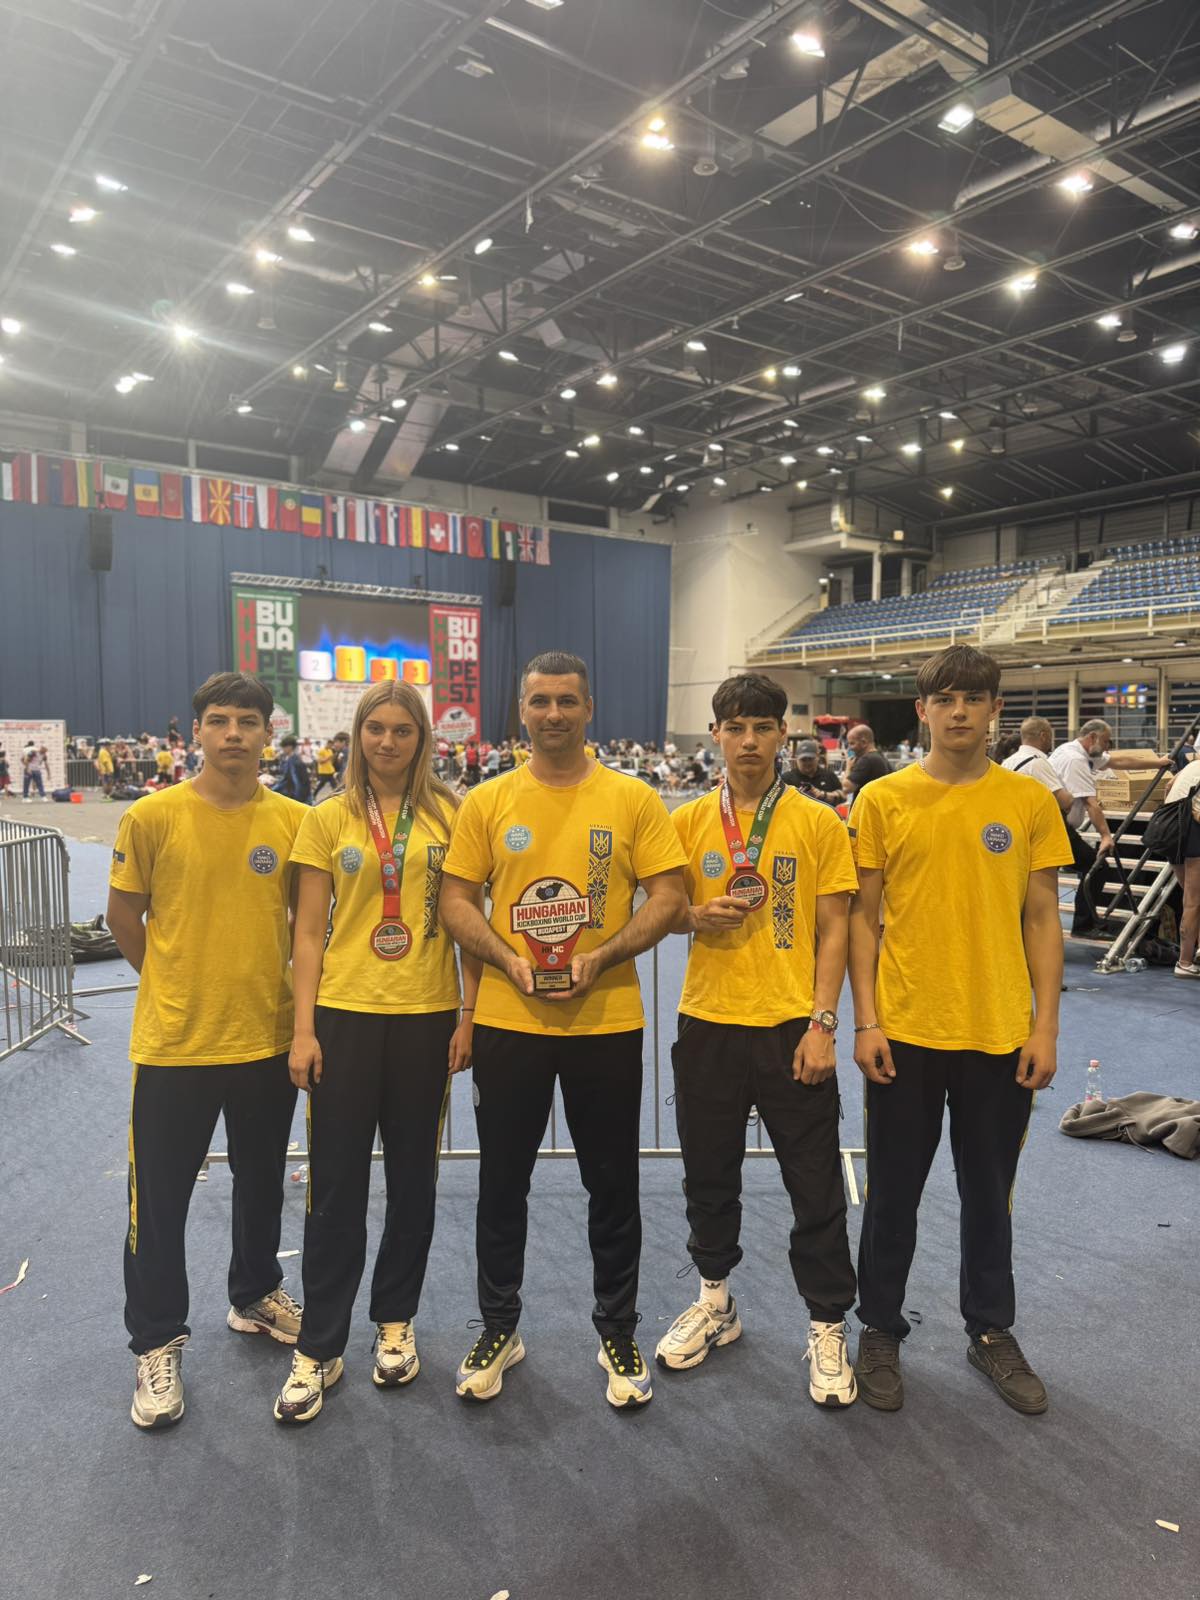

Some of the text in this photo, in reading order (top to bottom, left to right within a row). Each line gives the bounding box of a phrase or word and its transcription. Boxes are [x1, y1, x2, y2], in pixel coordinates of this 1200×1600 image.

[312, 660, 320, 671] 2
[347, 658, 353, 672] 1
[516, 901, 586, 921] HUNGARIAN
[516, 917, 552, 928] KICKBOXING
[552, 915, 574, 924] WORLD
[537, 926, 566, 935] BUDAPEST
